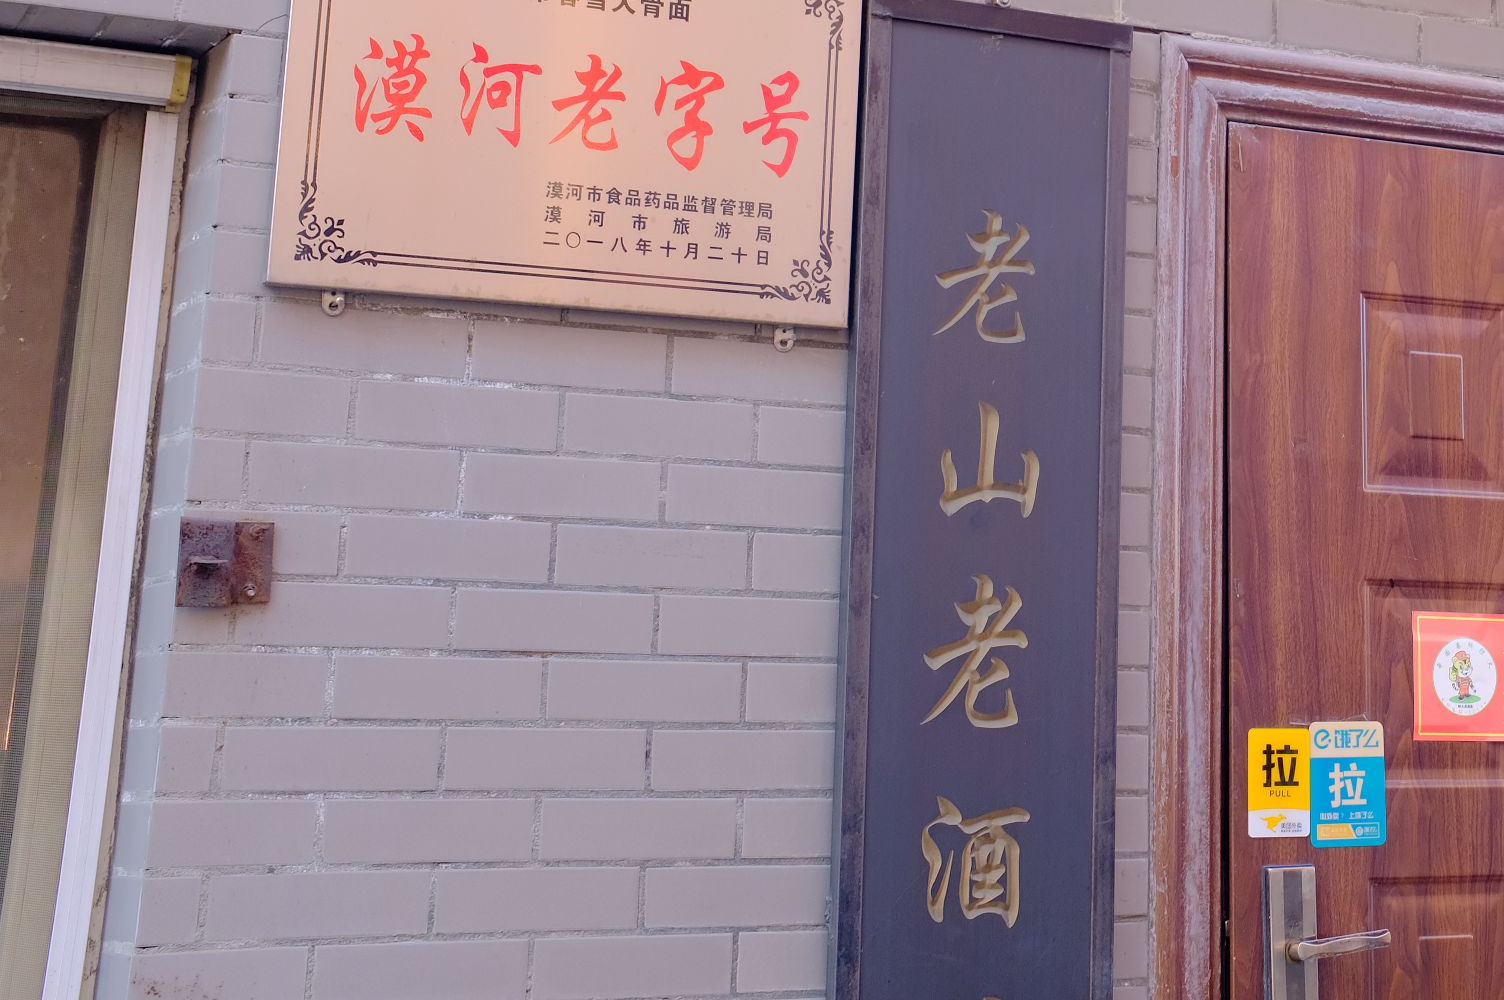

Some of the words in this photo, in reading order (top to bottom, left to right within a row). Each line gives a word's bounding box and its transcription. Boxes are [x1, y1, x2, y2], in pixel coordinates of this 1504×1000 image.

[353, 33, 810, 179] 漠河老字号
[545, 181, 773, 220] 漠河市食品药品监督管理局
[544, 205, 772, 243] 漠河市旅游局
[1262, 743, 1299, 788] 拉
[1329, 762, 1367, 808] 拉
[1269, 789, 1292, 797] PULL
